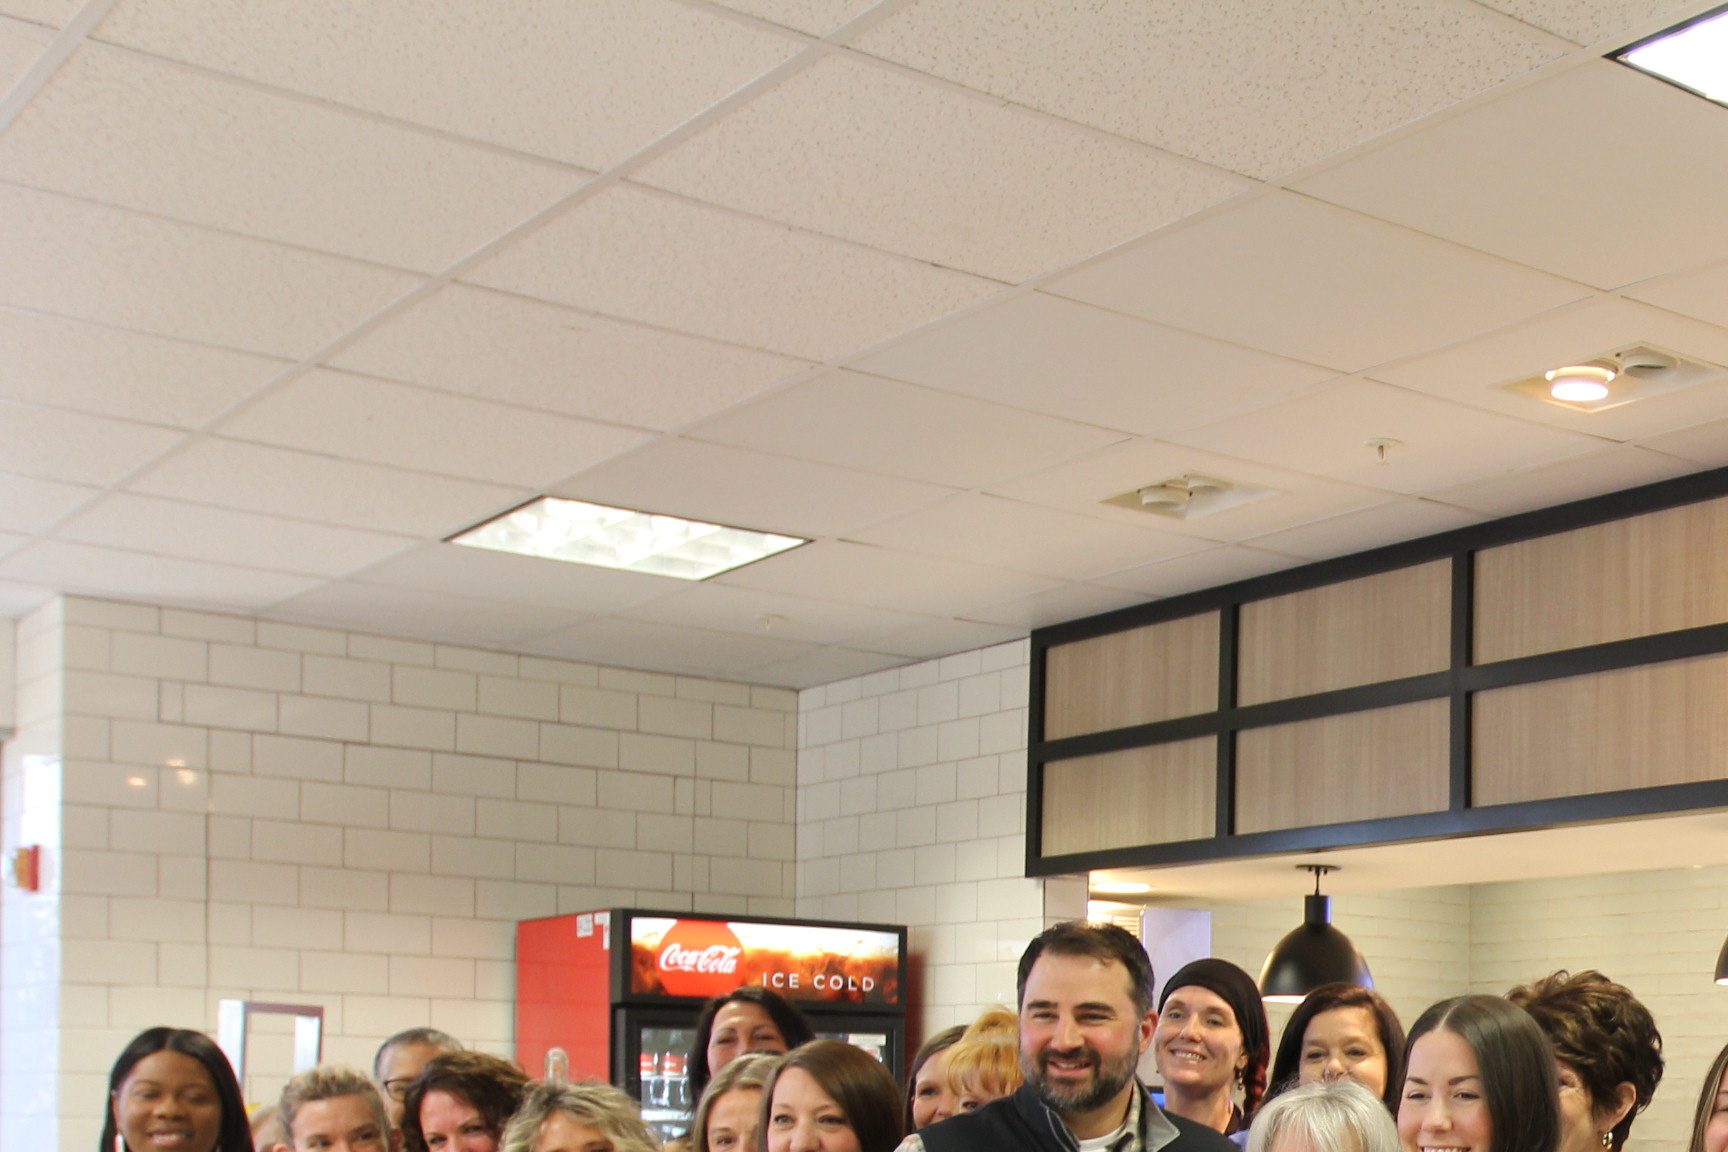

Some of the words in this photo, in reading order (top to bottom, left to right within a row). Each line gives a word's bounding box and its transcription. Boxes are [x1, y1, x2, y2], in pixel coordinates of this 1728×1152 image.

[659, 943, 741, 975] Coca-Cola
[762, 971, 800, 989] ICE
[813, 974, 876, 993] COLD
